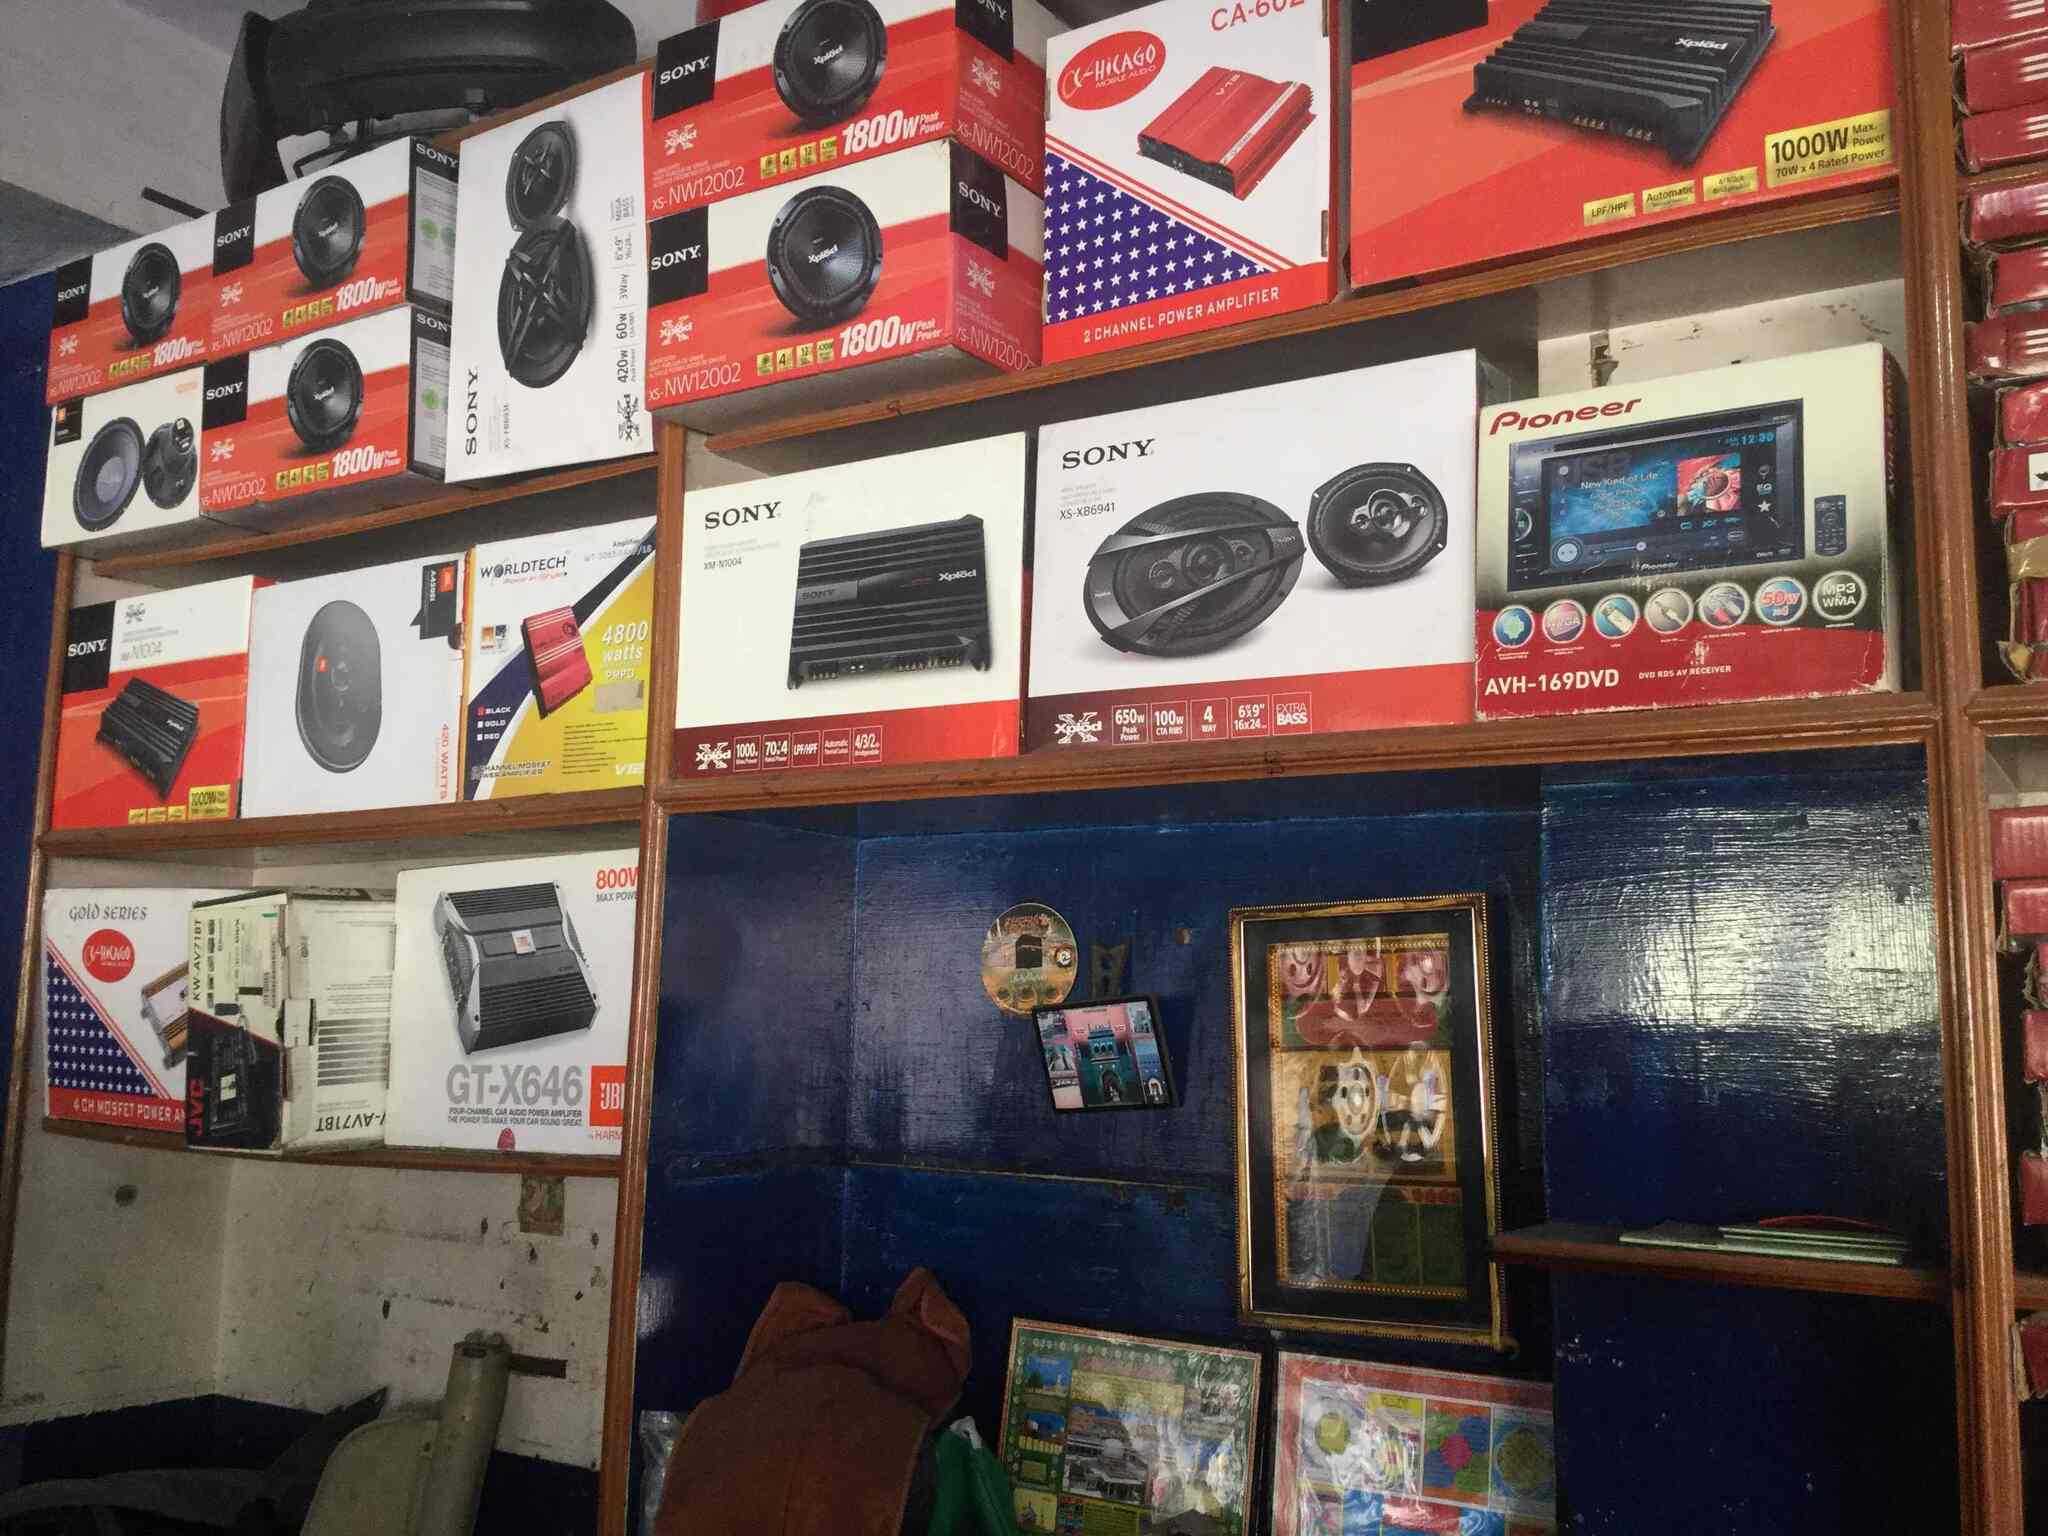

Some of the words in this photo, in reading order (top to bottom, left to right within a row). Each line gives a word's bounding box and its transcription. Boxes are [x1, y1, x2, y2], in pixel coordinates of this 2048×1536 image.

[660, 56, 710, 84] SONY
[842, 110, 920, 156] 1800W
[1852, 132, 1886, 148] Power
[416, 143, 459, 168] SONY
[1771, 127, 1849, 163] 1000W
[1776, 164, 1799, 178] 70W
[1818, 155, 1848, 169] Rated
[1851, 147, 1886, 163] Power
[959, 181, 1001, 217] SONY
[1646, 186, 1693, 201] Automatic
[1591, 202, 1628, 217] LPF/HPF
[216, 226, 250, 247] SONY
[651, 245, 702, 271] SONY
[57, 284, 87, 301] SONY
[336, 277, 386, 311] 1800W
[416, 313, 452, 332] SON
[1083, 330, 1091, 343] 2
[1094, 317, 1154, 341] CHANNEL
[1158, 303, 1203, 326] POWER
[1207, 286, 1280, 314] AMPLIFIER
[839, 315, 916, 358] 1800W
[206, 382, 245, 400] SONY
[465, 368, 479, 456] SONY
[1489, 398, 1642, 435] Pioneer
[332, 445, 384, 479] 1800W
[1061, 438, 1155, 471] SONY
[704, 501, 781, 529] SONY
[1822, 583, 1857, 596] MP3
[1822, 597, 1857, 609] WMA
[601, 621, 649, 645] 4800
[68, 638, 108, 657] SONY
[1484, 669, 1619, 696] AVH-169DVD
[1638, 671, 1655, 680] DVD
[1676, 669, 1688, 677] AV
[1690, 665, 1732, 676] RECEIVER
[485, 706, 511, 714] BLACK
[1204, 705, 1213, 723] 4
[1276, 702, 1306, 714] EXTRA
[1200, 724, 1217, 733] WAY
[1277, 712, 1308, 726] BASS
[446, 1064, 583, 1106] GT-X646
[97, 1100, 134, 1117] MOSFET
[137, 1104, 171, 1121] POWER
[509, 1108, 527, 1116] AUDIO
[528, 1108, 549, 1117] POWER
[551, 1109, 582, 1118] AMPLIFIER
[315, 1111, 387, 1132] -AV71BT
